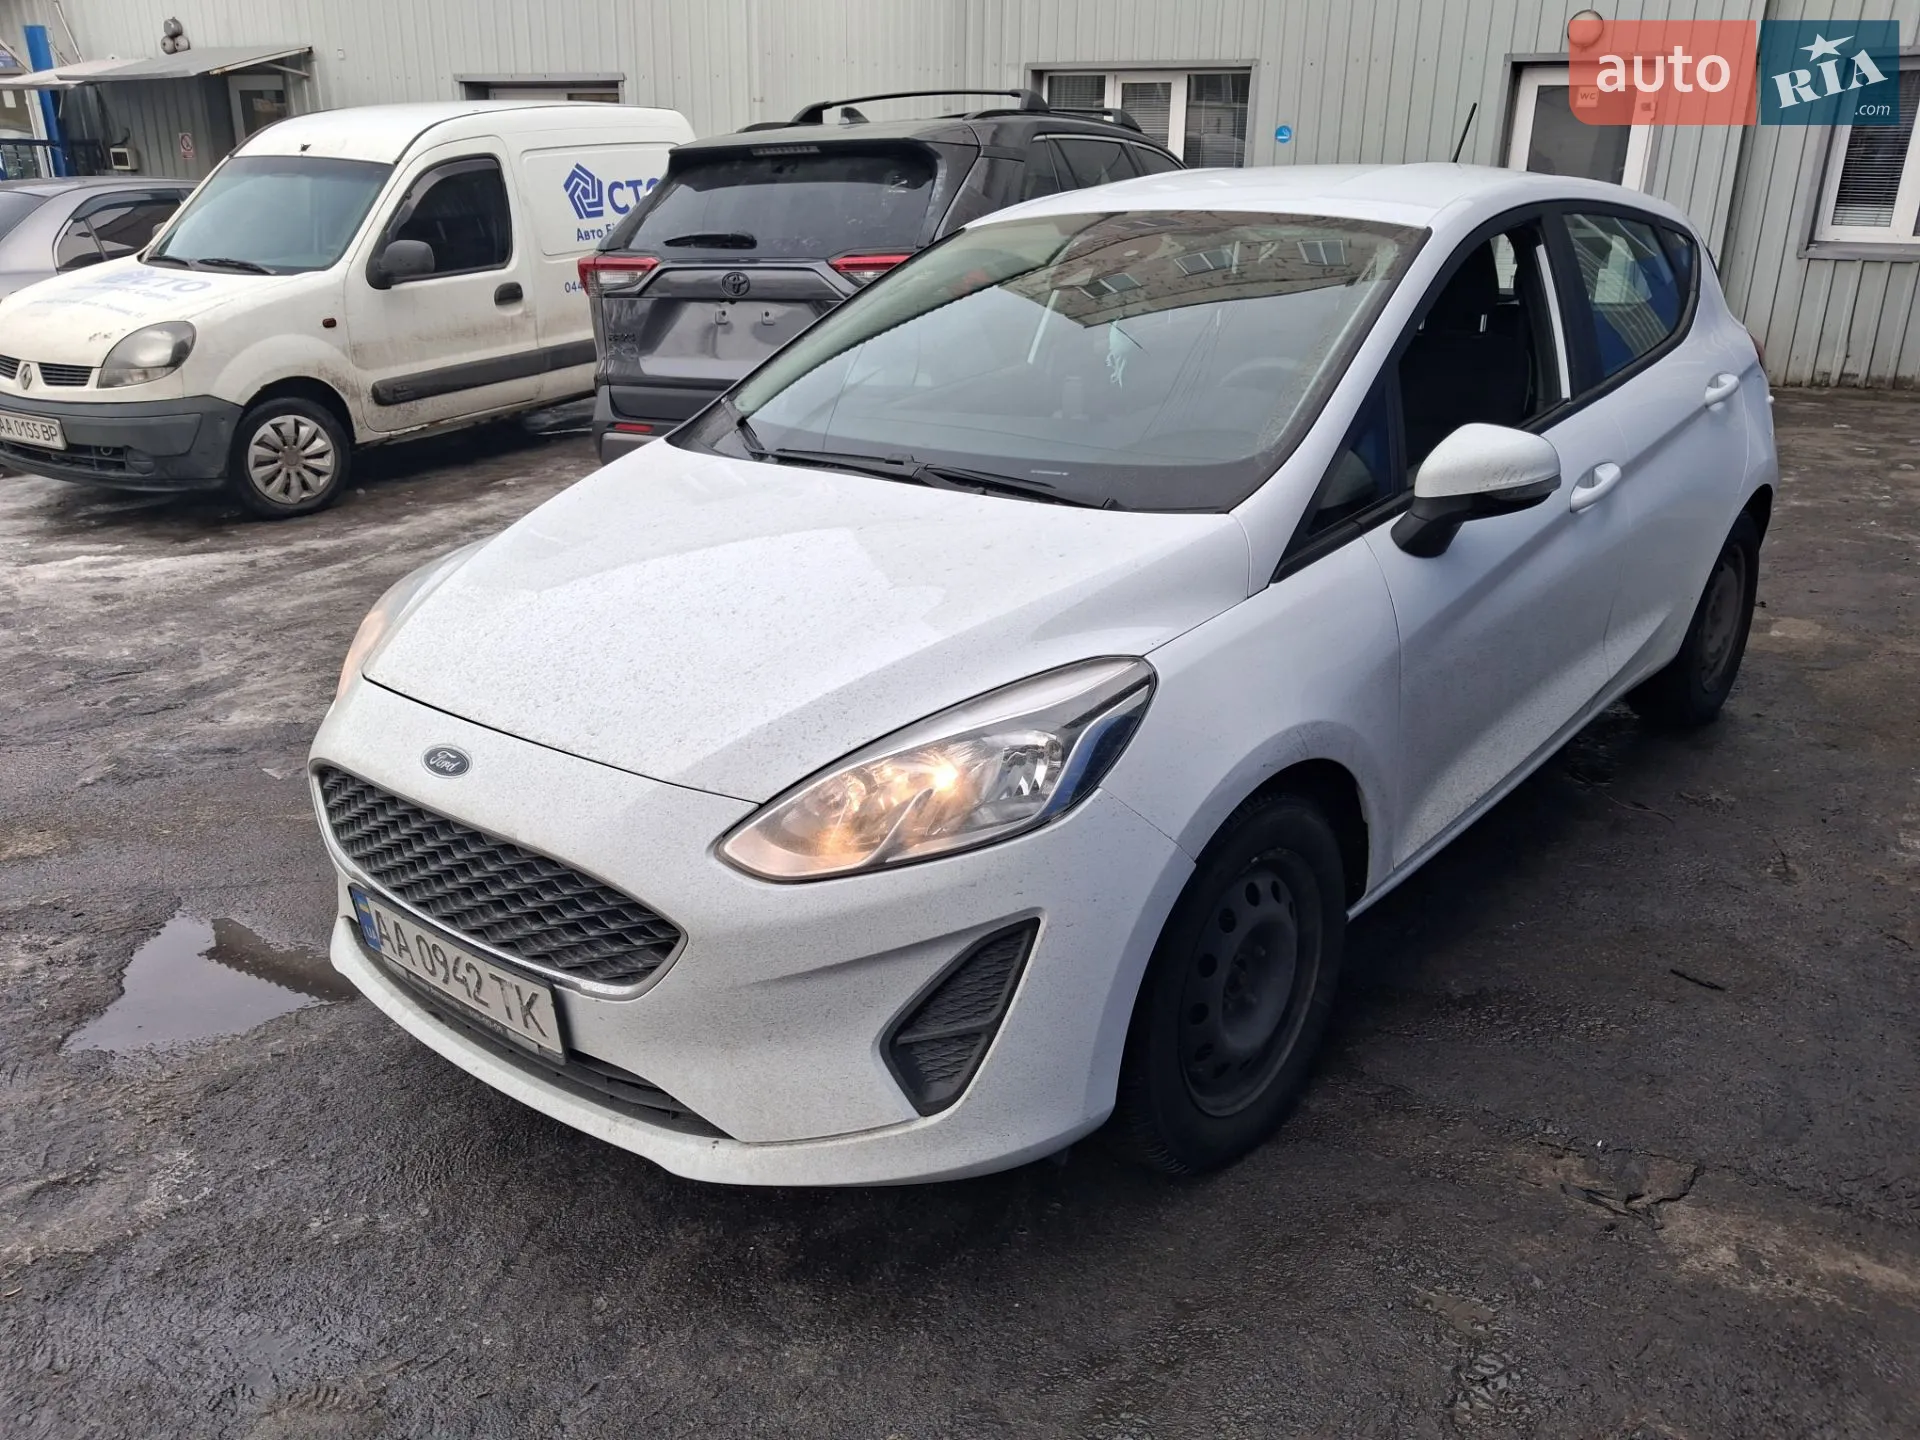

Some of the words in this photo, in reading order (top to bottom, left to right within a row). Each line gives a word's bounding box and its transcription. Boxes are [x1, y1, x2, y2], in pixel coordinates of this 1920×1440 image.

[1580, 92, 1596, 100] WC
[14, 420, 42, 440] 0155
[430, 750, 460, 772] Ford
[375, 909, 416, 967] AA
[416, 934, 491, 1009] 0942
[488, 972, 549, 1039] TK
